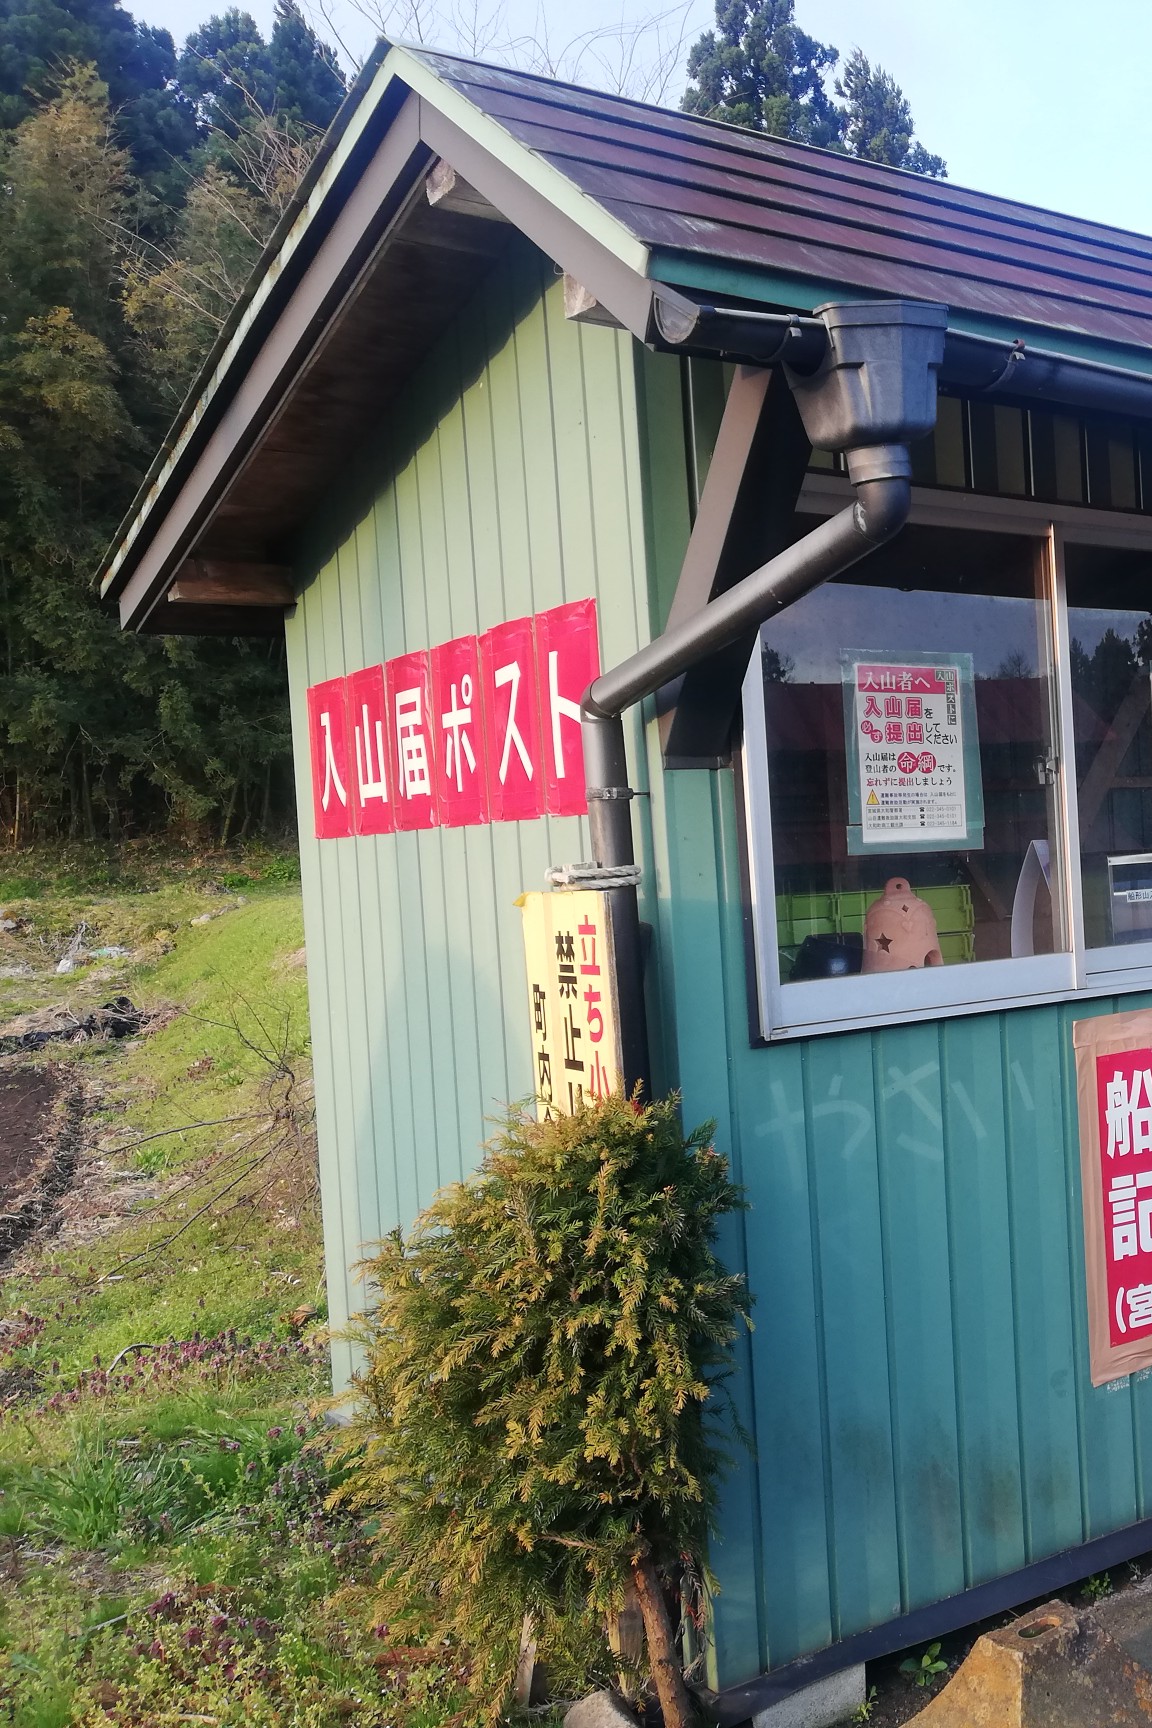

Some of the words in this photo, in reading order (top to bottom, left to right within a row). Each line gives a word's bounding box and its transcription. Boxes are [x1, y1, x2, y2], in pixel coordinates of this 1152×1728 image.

[863, 671, 931, 691] 入山者へ
[864, 696, 934, 719] 入山届を
[321, 650, 584, 812] 入山届ポスト
[532, 983, 553, 1121] 町内
